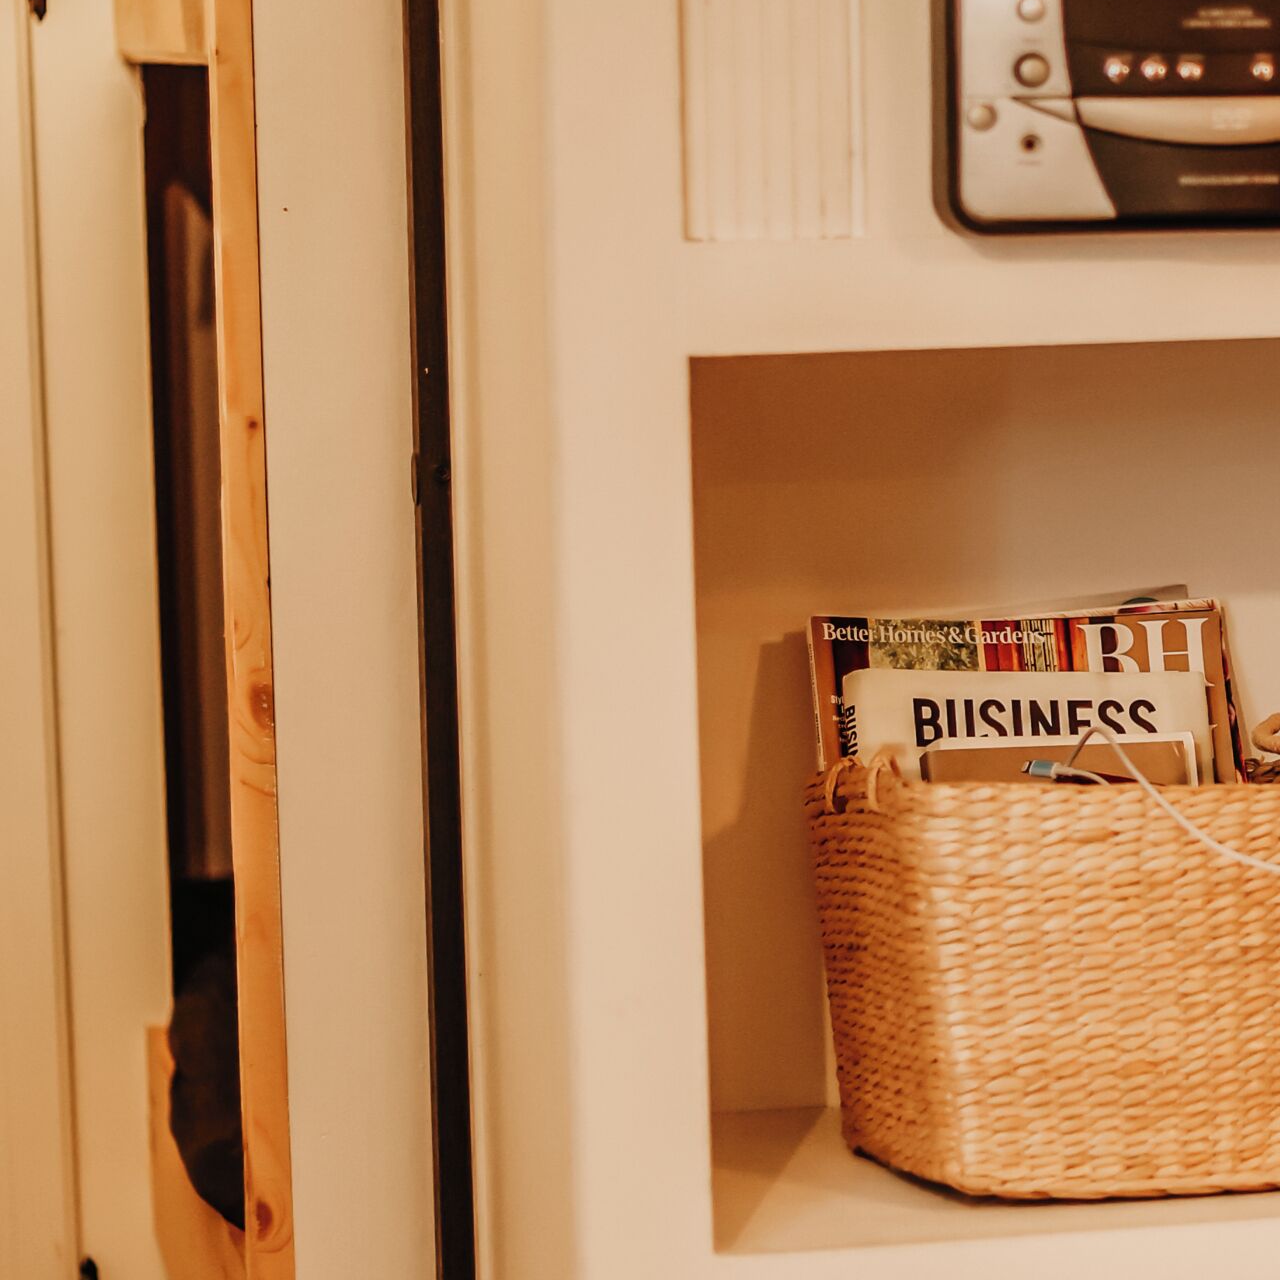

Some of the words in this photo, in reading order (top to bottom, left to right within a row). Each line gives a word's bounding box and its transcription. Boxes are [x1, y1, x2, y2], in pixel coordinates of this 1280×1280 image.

[822, 622, 876, 641] Better
[881, 625, 946, 644] Homes
[949, 627, 963, 644] &
[965, 626, 1046, 644] Gardens
[912, 697, 1158, 747] BUSINESS
